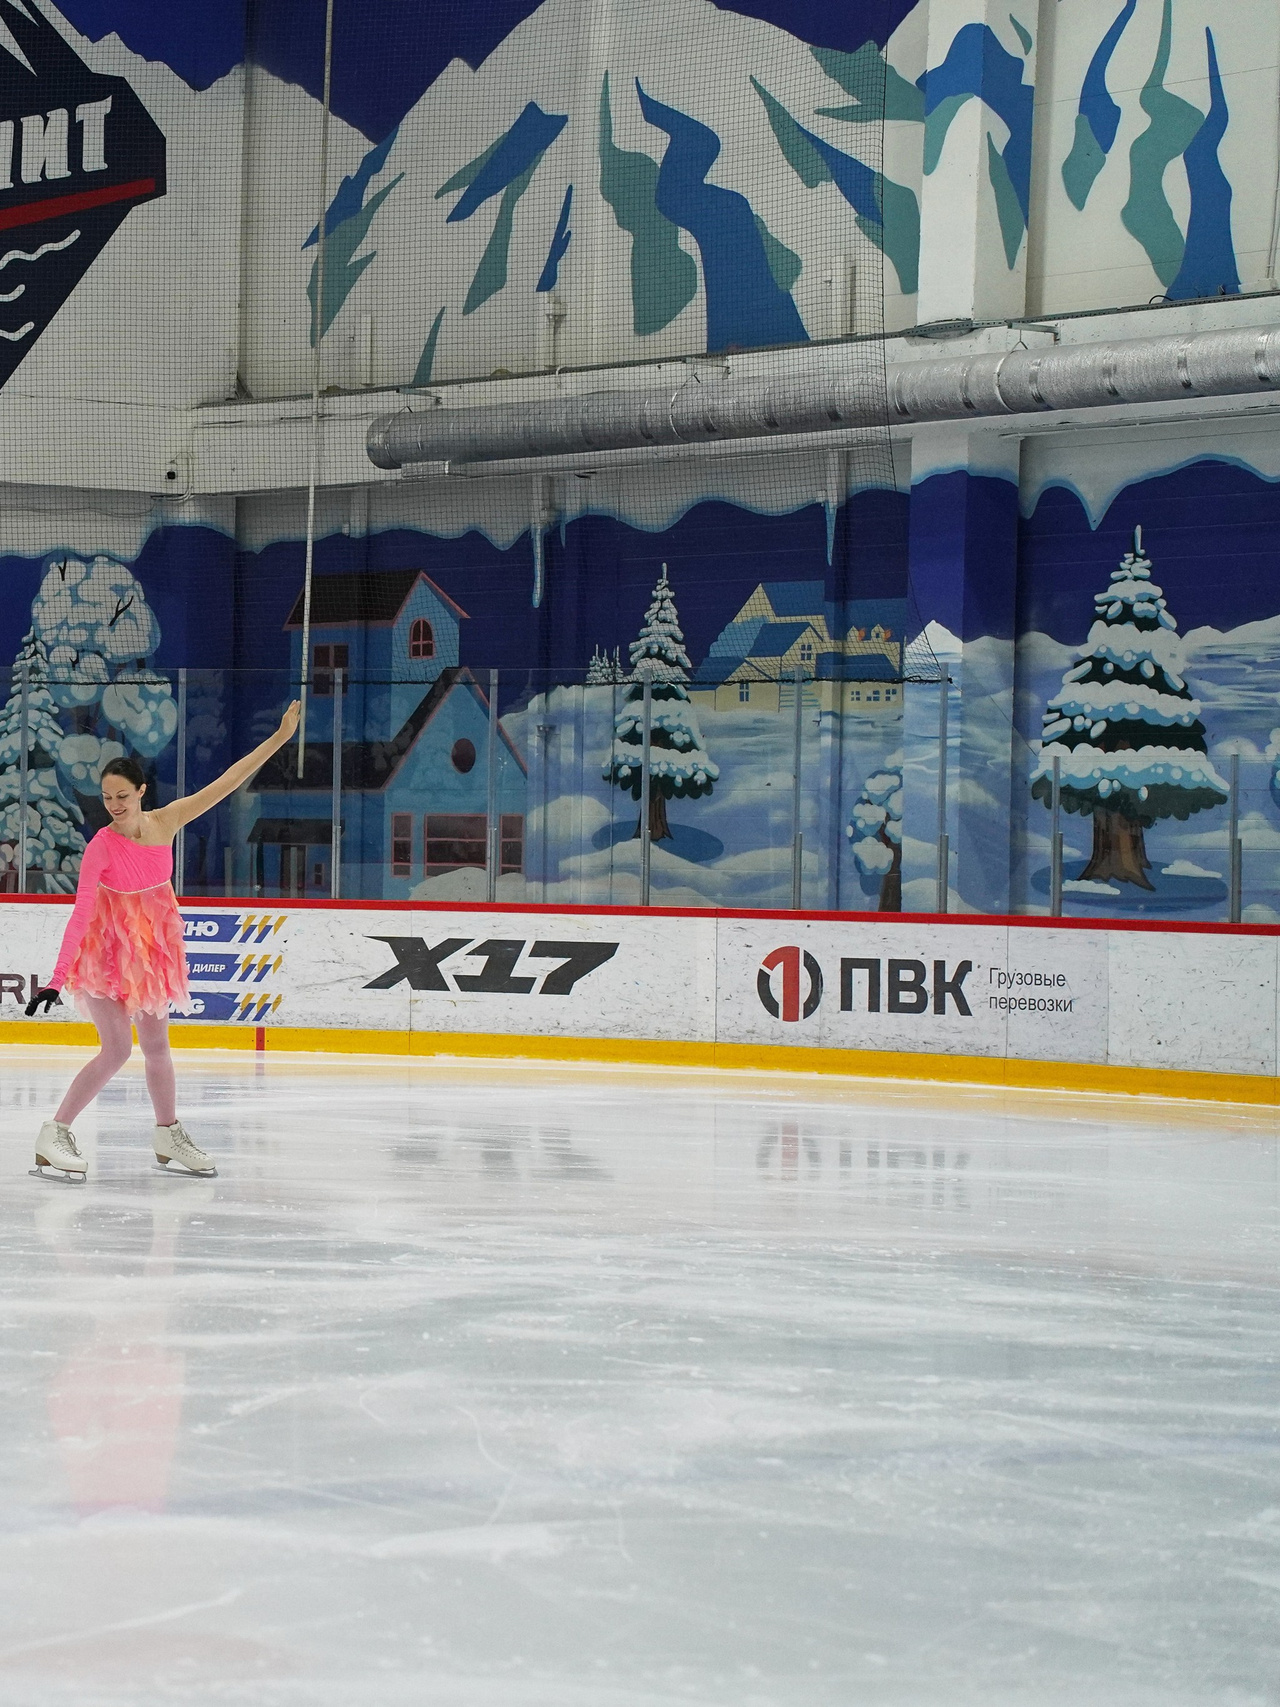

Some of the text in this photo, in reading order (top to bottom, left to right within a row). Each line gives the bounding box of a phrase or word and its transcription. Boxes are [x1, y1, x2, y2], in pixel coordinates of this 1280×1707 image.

[192, 963, 226, 974] ДИЛЕР
[361, 936, 620, 995] X17
[840, 957, 973, 1016] ПВК
[989, 967, 1066, 989] Грузовые
[989, 996, 1073, 1014] перевозки
